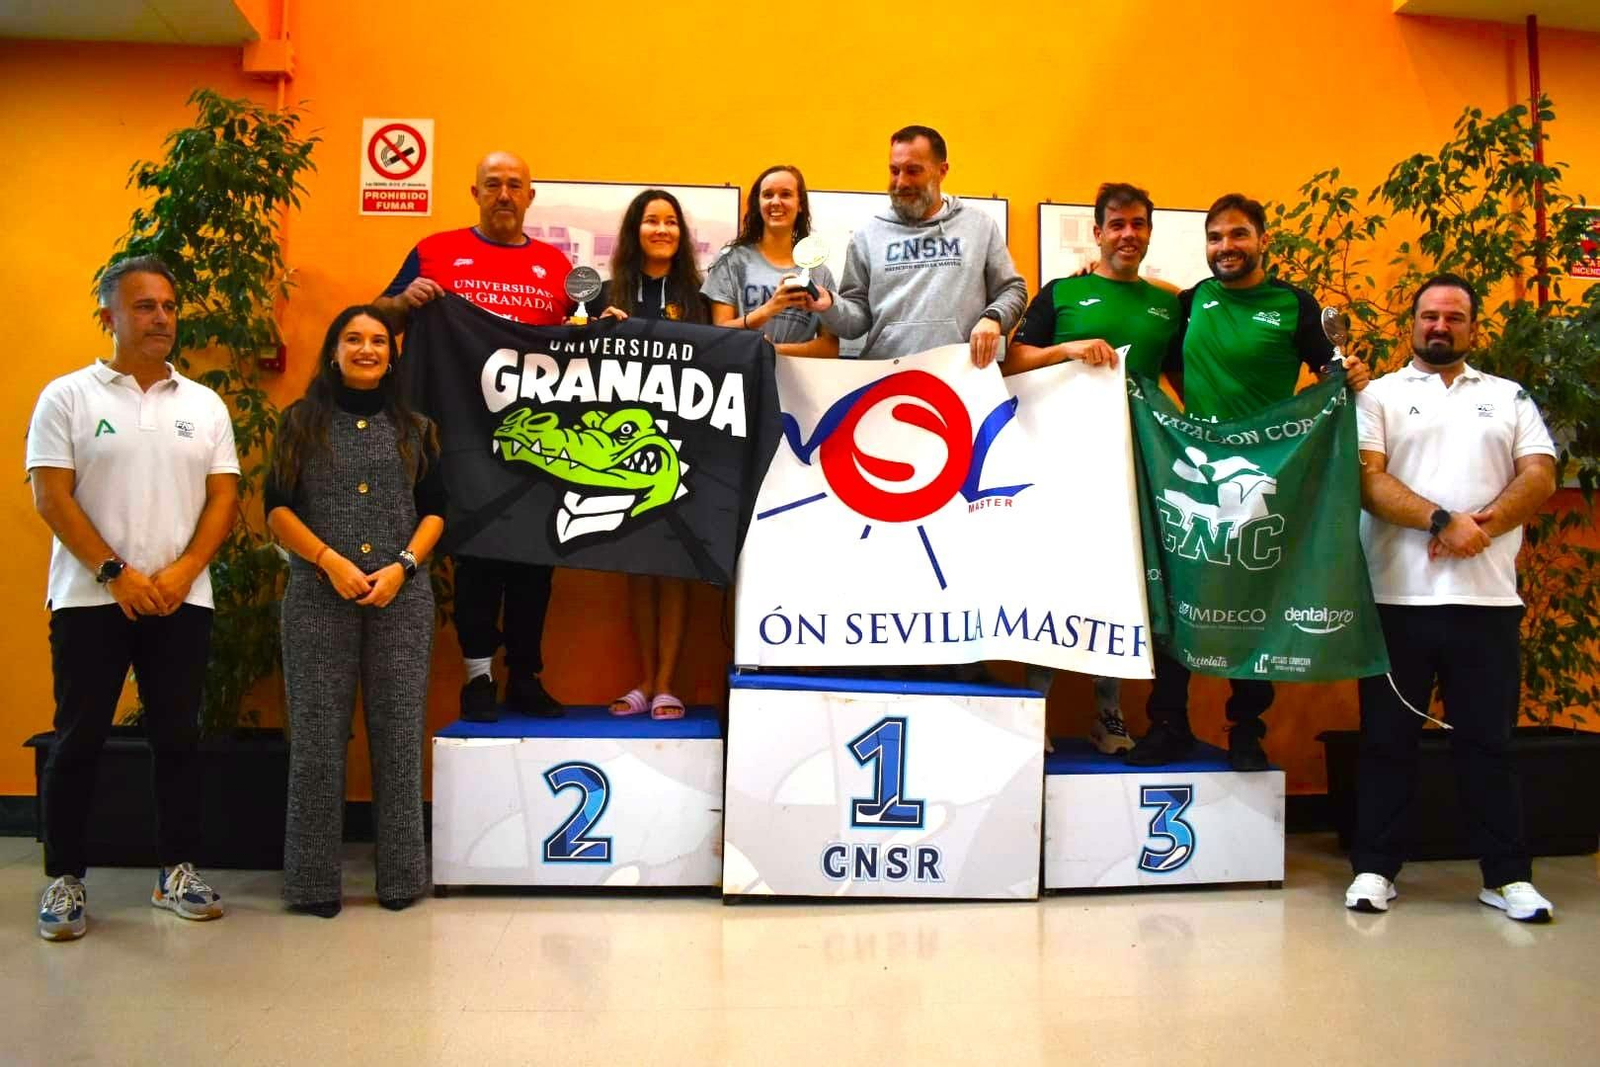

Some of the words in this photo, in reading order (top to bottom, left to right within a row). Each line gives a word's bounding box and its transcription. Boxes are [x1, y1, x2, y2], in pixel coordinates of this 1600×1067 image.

[364, 191, 427, 200] PROHIBIDO
[376, 201, 415, 210] FUMAR
[886, 237, 961, 262] CNSM
[475, 291, 554, 313] GRANADA
[549, 337, 694, 361] UNIVERSIDAD
[481, 348, 748, 438] GRANADA
[967, 498, 1013, 514] MASTER
[758, 606, 828, 646] ÓN
[845, 607, 983, 645] SEVILLA
[848, 717, 925, 828] 1
[543, 761, 612, 864] 2
[1138, 785, 1194, 872] 3
[822, 841, 945, 884] CNSR
